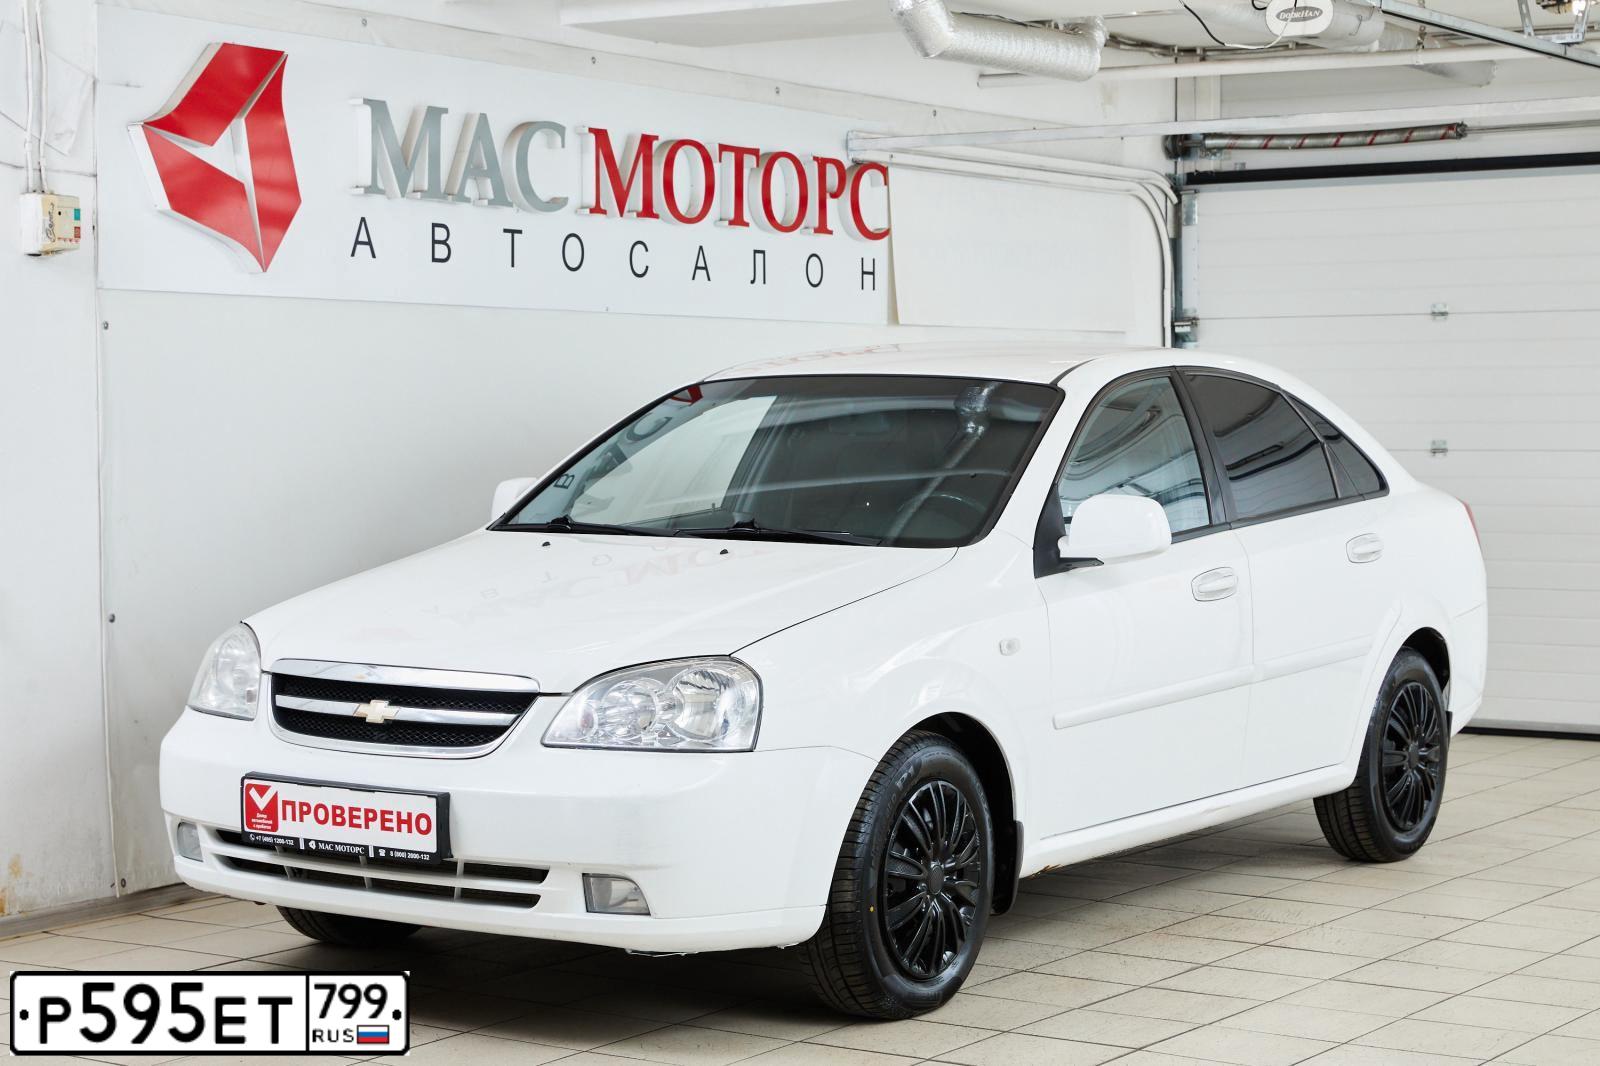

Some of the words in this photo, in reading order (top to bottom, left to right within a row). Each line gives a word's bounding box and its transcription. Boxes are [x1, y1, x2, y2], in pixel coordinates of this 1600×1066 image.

[353, 97, 569, 213] МАС
[580, 126, 890, 242] МОТОРС
[350, 216, 876, 291] АВТОСАЛОН
[281, 799, 433, 836] ПРОВЕРЕНО
[318, 842, 334, 851] МАС
[335, 844, 365, 854] МОТОРС
